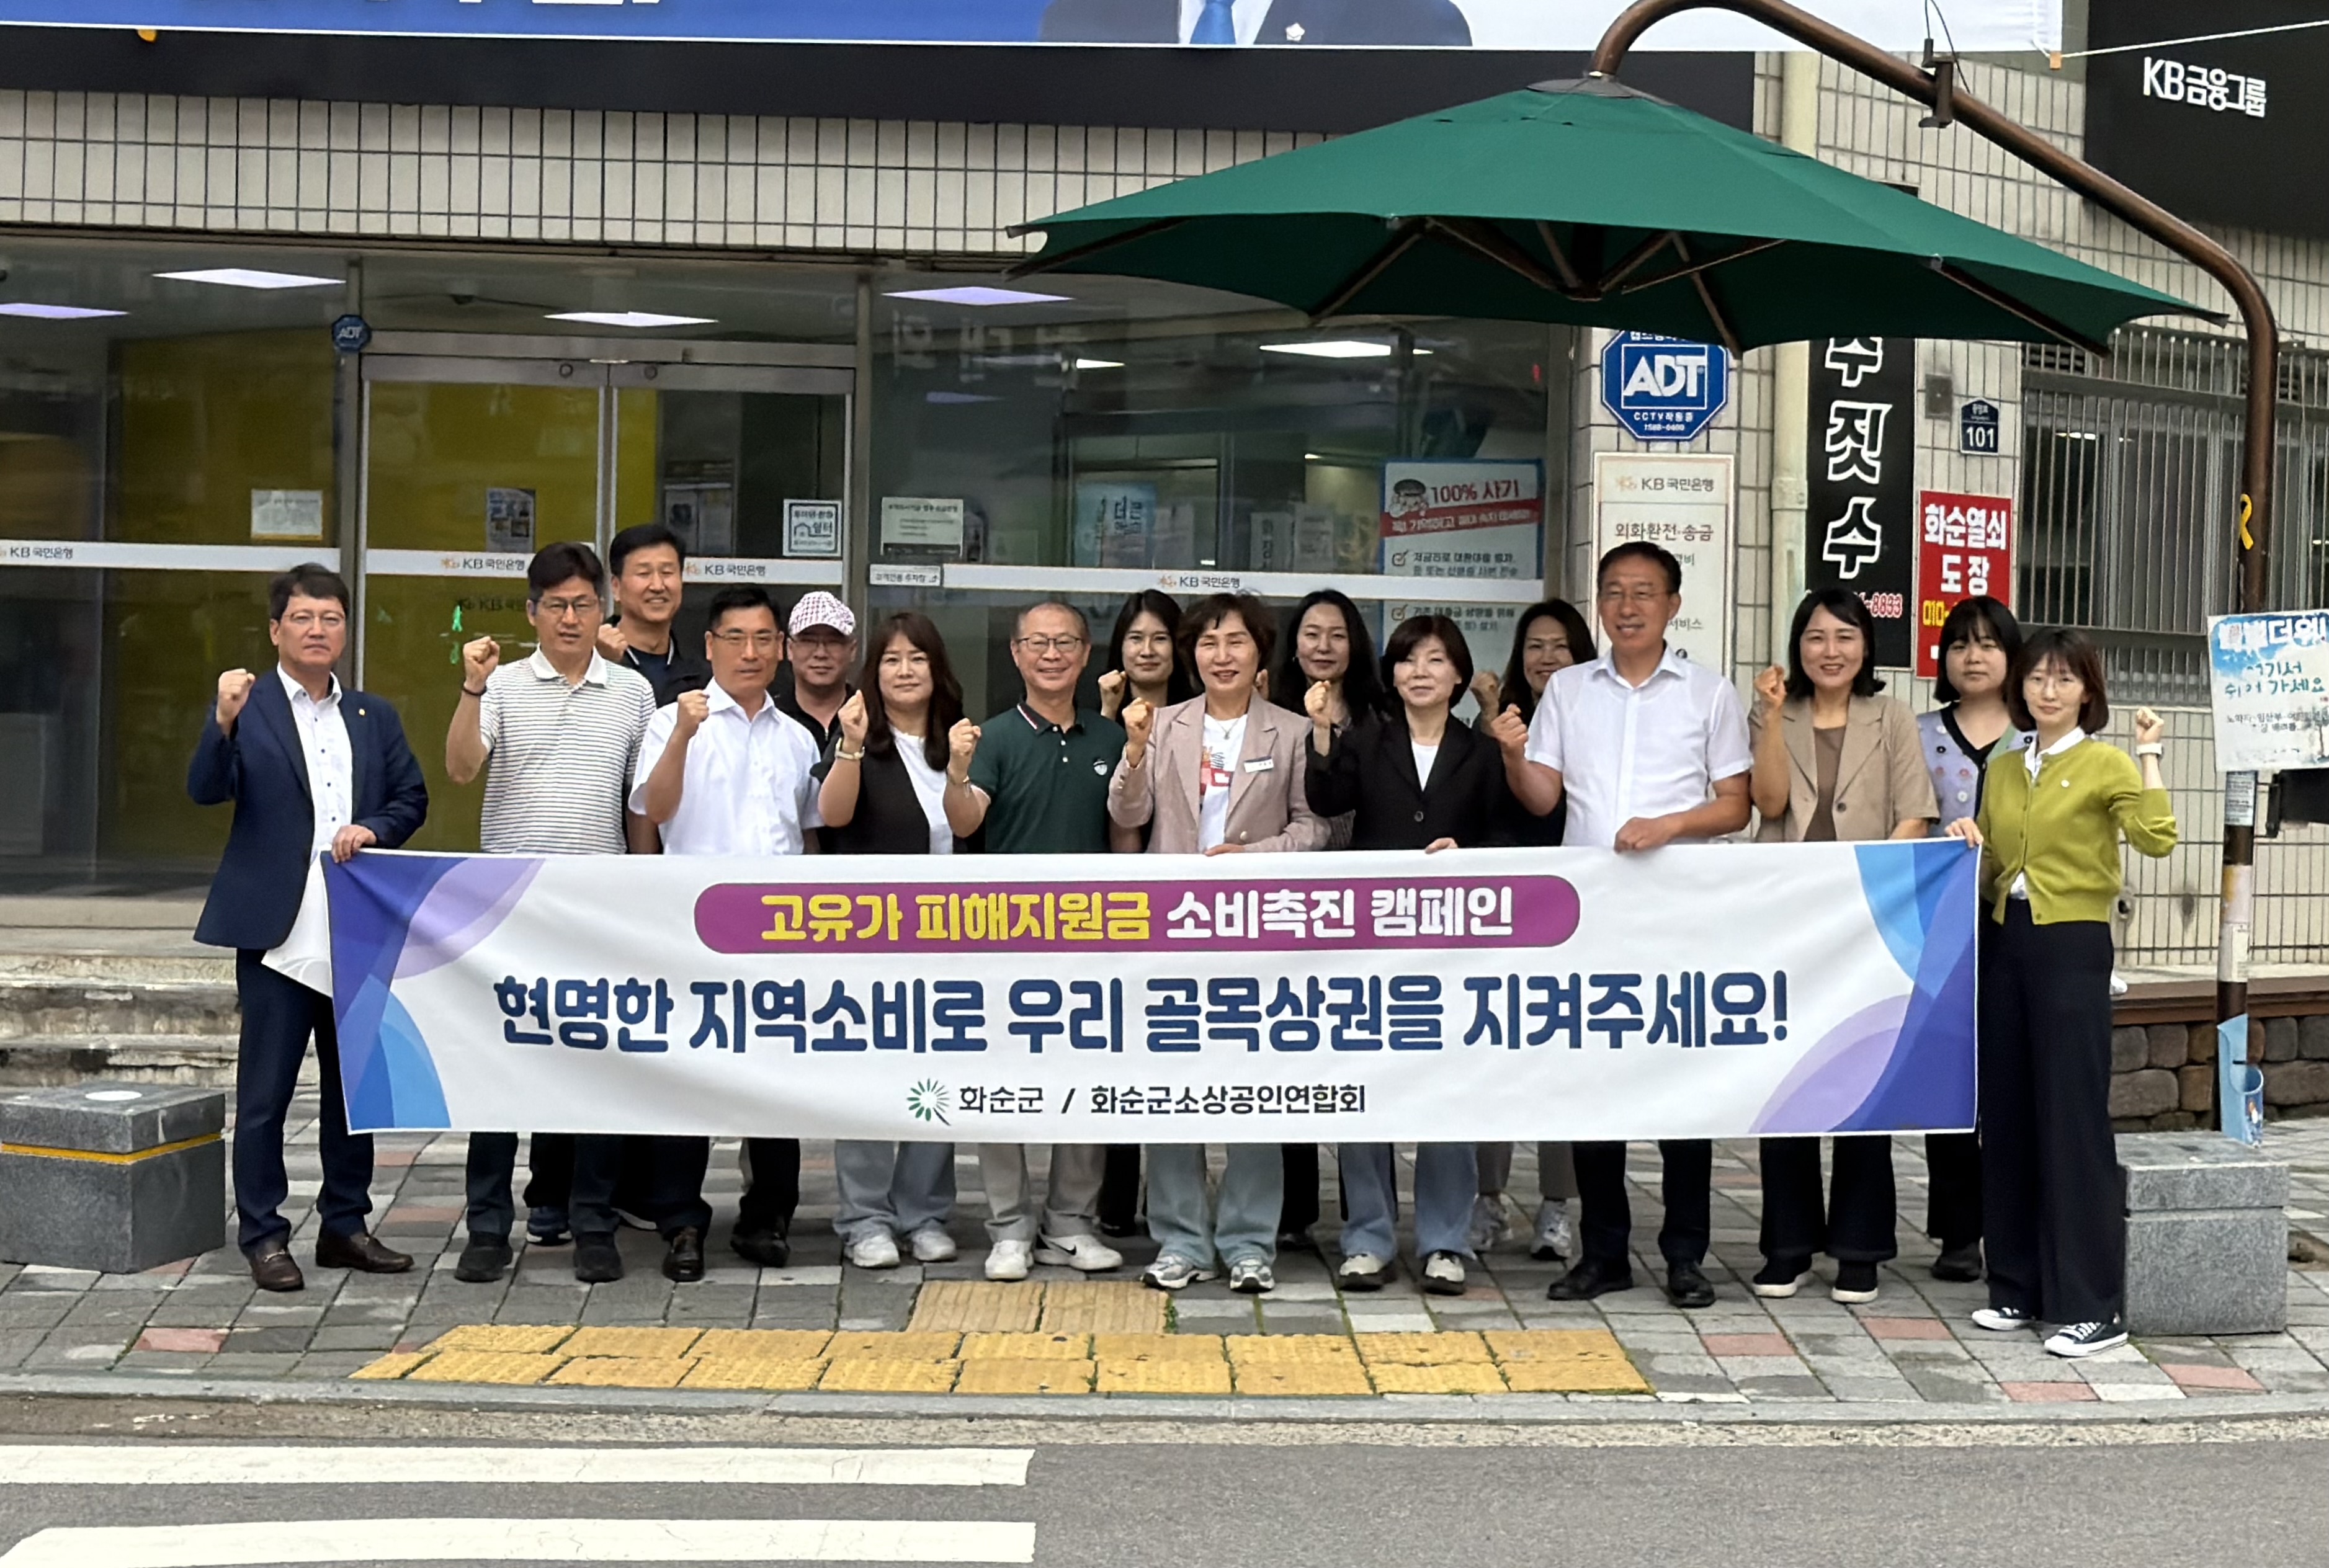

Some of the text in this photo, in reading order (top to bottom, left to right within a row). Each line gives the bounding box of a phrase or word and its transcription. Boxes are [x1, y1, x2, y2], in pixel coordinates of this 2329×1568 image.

[2143, 56, 2266, 118] KB금융그룹
[1623, 355, 1706, 397] ADT
[1966, 426, 1994, 448] 101
[1429, 479, 1519, 504] 100% 사기
[1667, 478, 1714, 492] 국민은행
[1614, 523, 1714, 541] 외화환전·송금
[1924, 504, 2006, 550] 화순열쇠
[32, 546, 74, 559] 국민은행
[485, 558, 525, 571] 국민은행
[726, 564, 766, 577] 국민은행
[1941, 555, 1990, 597] 도장
[1201, 576, 1240, 589] 국민은행
[2268, 677, 2325, 695] 가세요
[762, 886, 1513, 941] 고유가 피해지원금 소비촉진 캠페인
[493, 971, 1788, 1053] 현명한 지역소비로 우리 골목상권을 지켜주세요!
[959, 1084, 1366, 1115] 화순군 / 화순군소상공인연합회
